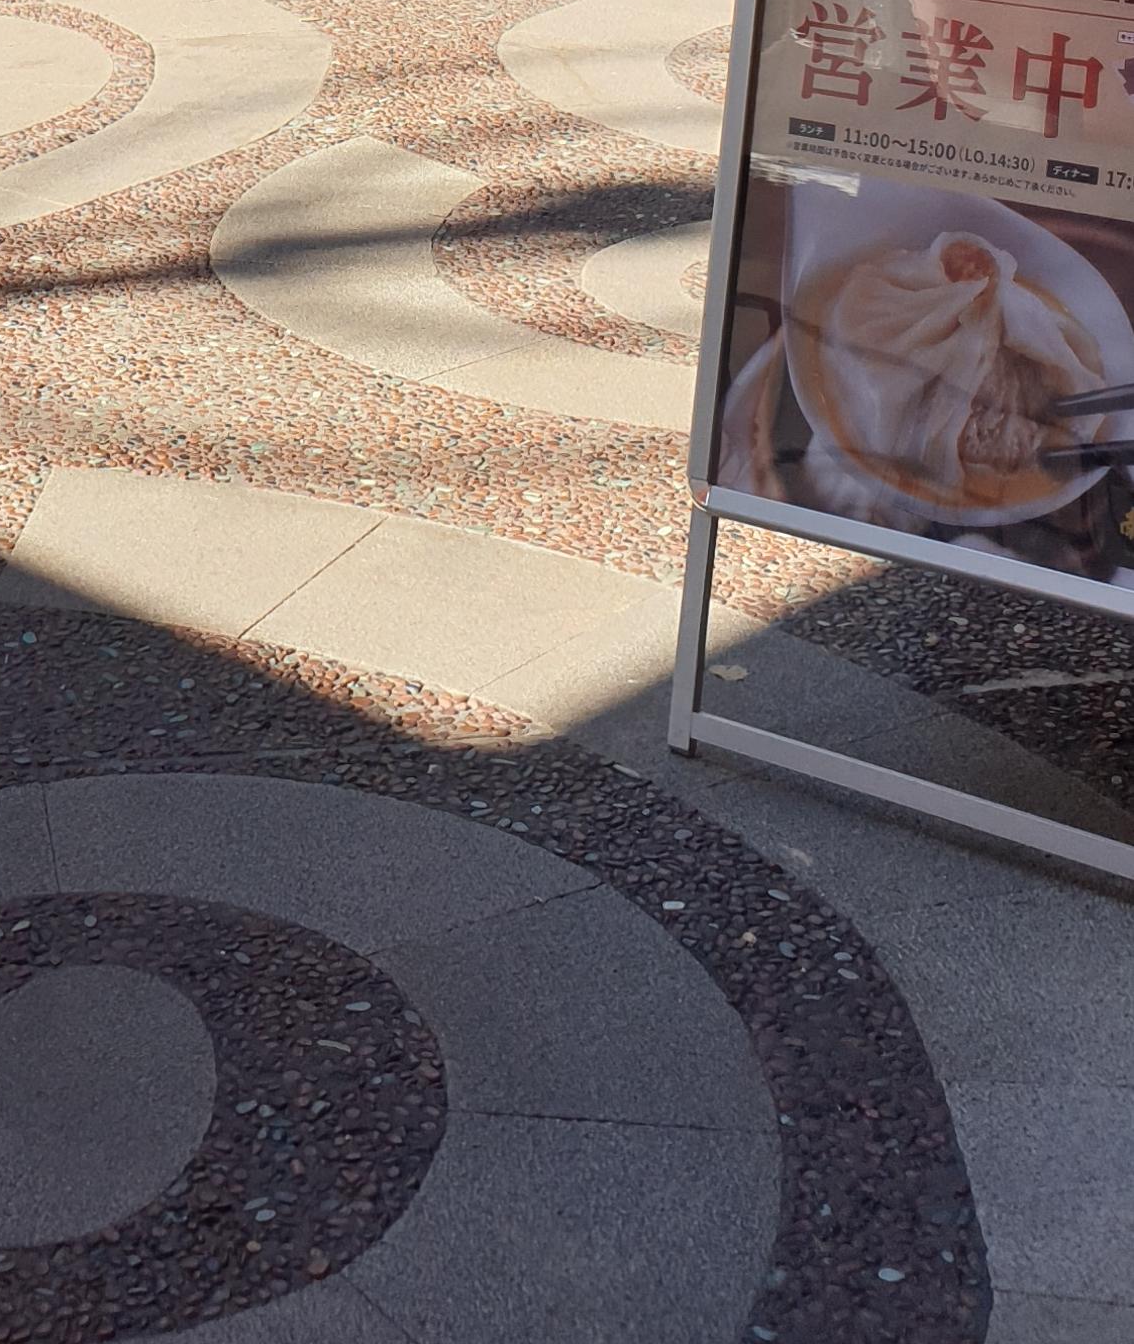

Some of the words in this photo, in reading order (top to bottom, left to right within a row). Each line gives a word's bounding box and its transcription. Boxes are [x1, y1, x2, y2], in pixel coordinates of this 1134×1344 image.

[794, 1, 1104, 138] 営業中
[1052, 165, 1091, 179] ディナー
[1105, 170, 1134, 191] 17:
